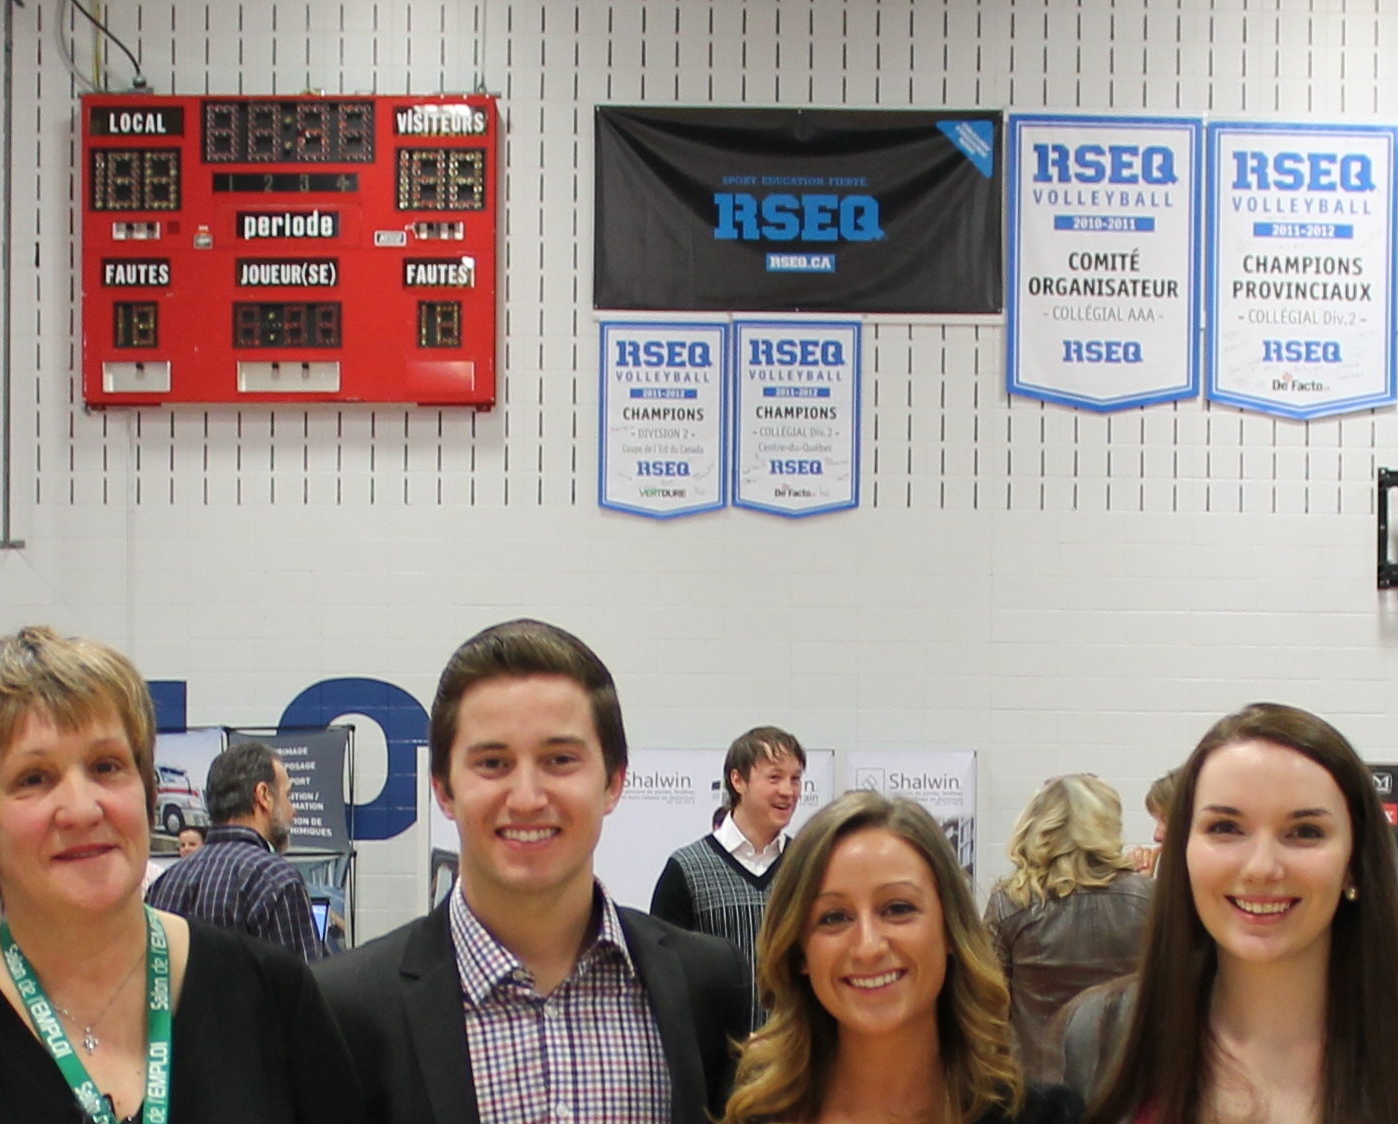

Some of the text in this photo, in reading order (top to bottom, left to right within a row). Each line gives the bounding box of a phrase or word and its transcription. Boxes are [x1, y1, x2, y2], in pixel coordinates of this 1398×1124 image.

[109, 113, 167, 133] LOCAL
[396, 111, 485, 134] VISITEURS
[1033, 143, 1179, 185] RSEQ
[1232, 150, 1376, 192] RSEQ
[1033, 189, 1174, 208] VOLLEYBALL
[1232, 196, 1372, 215] VOLLEYBALL
[713, 192, 886, 242] RSEQ
[1073, 217, 1137, 231] 2010-2011
[1271, 223, 1335, 238] 2011-2012
[770, 255, 832, 270] RSEQ.CA
[1068, 248, 1140, 272] COMITÉ
[1242, 254, 1363, 275] CHAMPIONS
[105, 263, 170, 285] FAUTES
[240, 262, 337, 286] JOUEUR(SE)
[406, 263, 468, 285] FAUTES
[1028, 277, 1179, 299] ORGANISATEUR
[1232, 281, 1372, 302] PROVINCIAUX
[1052, 304, 1156, 322] COLLÉGIAL AAA
[1248, 306, 1357, 326] COLLÉGIAL Div.2
[616, 340, 712, 368] RSEQ
[749, 339, 845, 366] RSEQ
[1062, 340, 1144, 364] RSEQ
[1262, 340, 1343, 364] RSEQ
[616, 371, 710, 383] VOLLEYBALL
[749, 370, 842, 382] VOLLEYBALL
[1272, 378, 1323, 392] De Facto
[622, 406, 705, 422] CHAMPIONS
[755, 405, 837, 420] CHAMPIONS
[638, 429, 689, 439] DIVISION 2
[759, 425, 807, 438] COLLÉGIAL
[636, 461, 690, 476] RSEQ
[769, 460, 823, 475] RSEQ
[788, 488, 811, 497] Facto
[623, 771, 692, 789] Shalwin
[888, 772, 960, 790] Shalwin
[151, 975, 169, 1011] Salon
